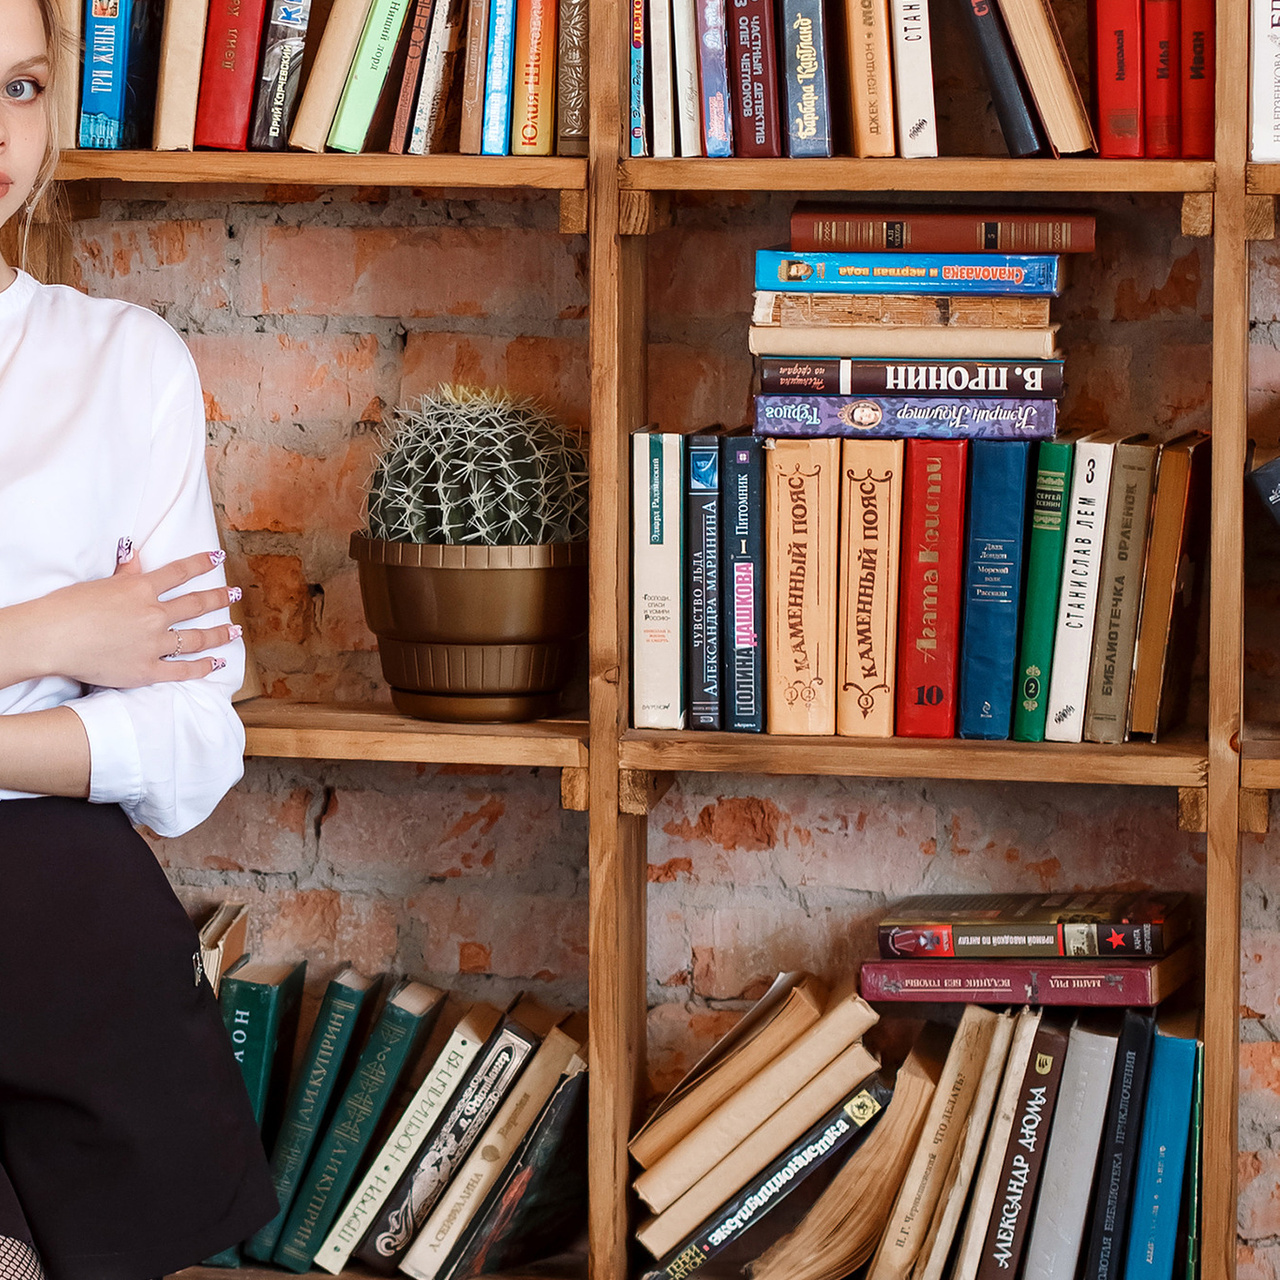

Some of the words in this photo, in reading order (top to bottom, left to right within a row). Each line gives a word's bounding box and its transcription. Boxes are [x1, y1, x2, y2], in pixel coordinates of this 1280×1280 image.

[93, 24, 115, 65] ЖЕНЫ
[793, 13, 818, 83] Картланд
[91, 70, 113, 93] ТРИ
[796, 85, 818, 139] Барбара
[886, 365, 1008, 391] ПРОНИН
[1015, 367, 1043, 391] В.
[1035, 492, 1062, 502] СЕРГЕЙ
[1085, 458, 1096, 484] 3
[787, 476, 808, 534] ПОЯС
[859, 482, 878, 541] ПОЯС
[1078, 496, 1096, 529] ЛЕМ
[693, 551, 703, 583] ЛЬДА
[1066, 537, 1092, 629] СТАНИСЛАВ
[1102, 575, 1125, 696] БИБЛИОТЕЧКА
[1117, 483, 1137, 561] ОРЛЕНОК
[693, 588, 703, 647] ЧУВСТВО
[787, 542, 810, 672] КАМЕННЫЙ
[856, 547, 879, 679] КАМЕННЫЙ
[1114, 1050, 1136, 1144] ПРИКЛЮЧЕНИЙ
[337, 1176, 388, 1243] ТЭФФИ
[389, 1049, 463, 1162] НОСТАЛЬГИЯ
[993, 1154, 1030, 1269] АЛЕКСАНДР
[1019, 1086, 1048, 1151] ДЮМА
[1106, 1152, 1123, 1231] БИБЛИОТЕКА
